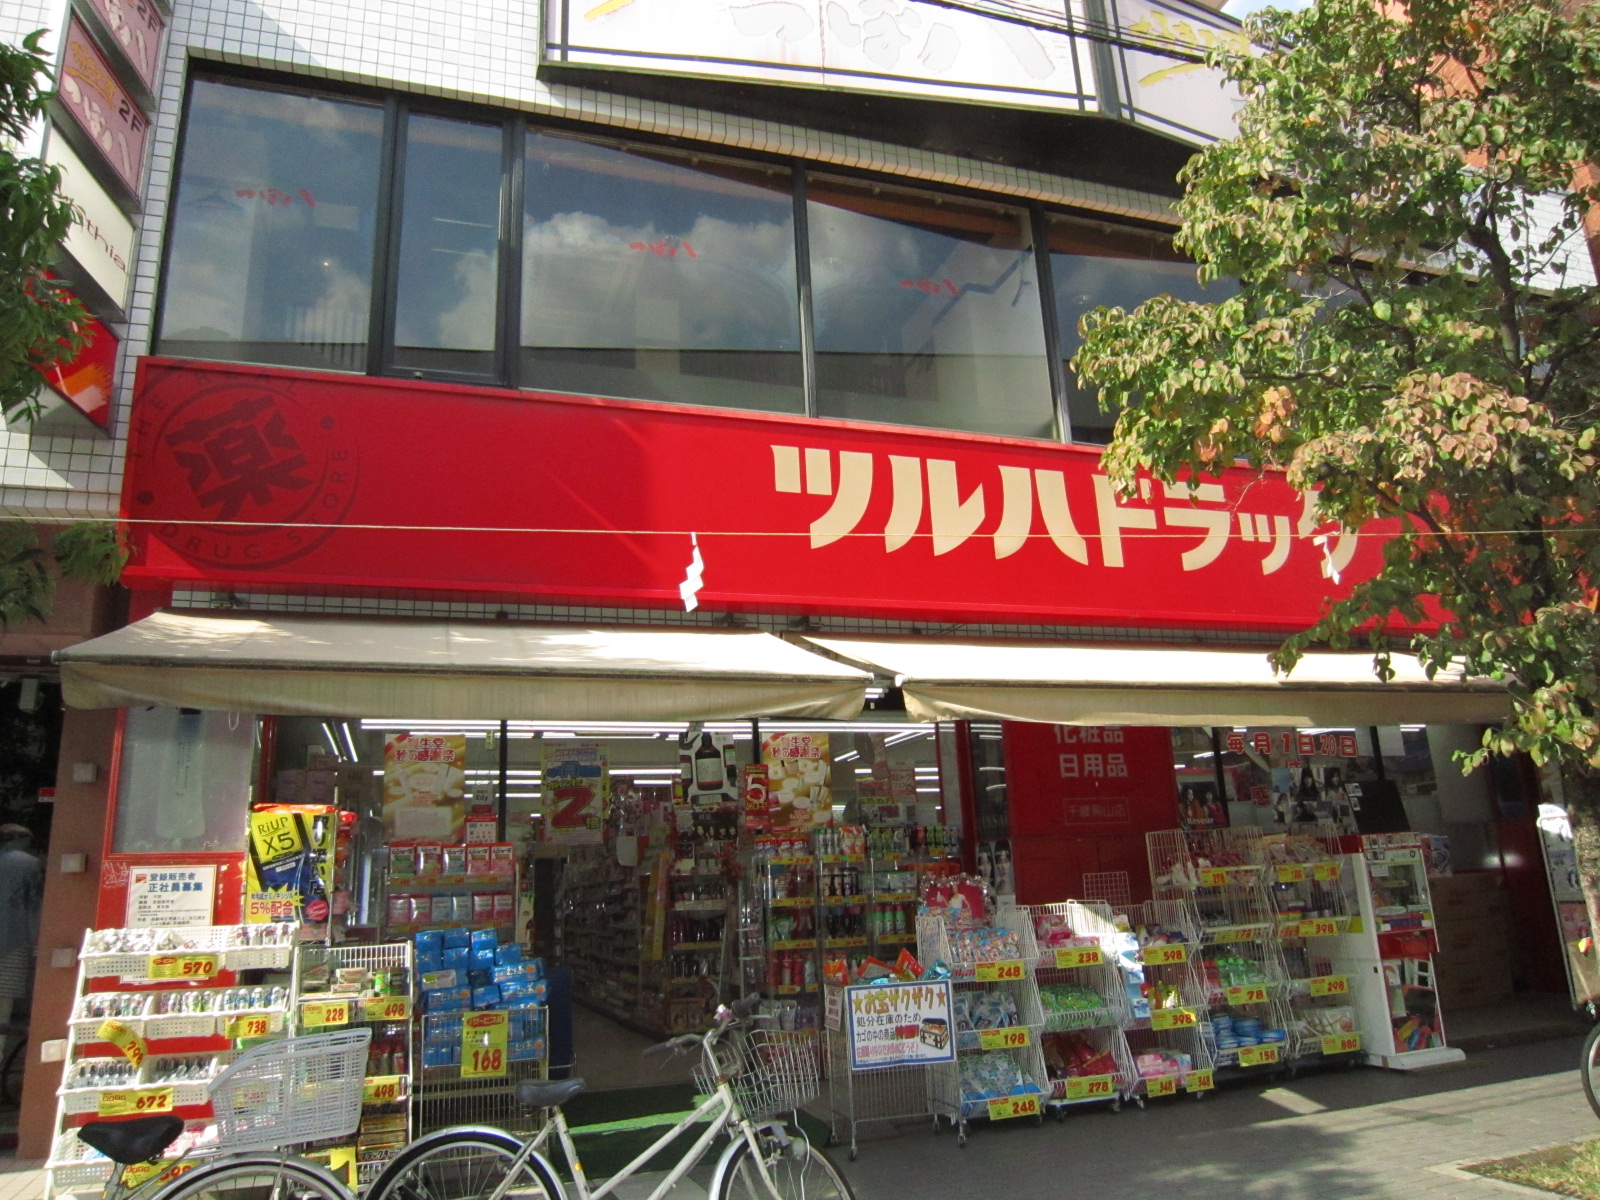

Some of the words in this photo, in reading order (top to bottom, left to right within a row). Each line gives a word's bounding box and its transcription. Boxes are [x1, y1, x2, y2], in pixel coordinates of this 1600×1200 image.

[119, 99, 142, 133] 2F
[1059, 753, 1128, 778] 日用品
[257, 816, 288, 835] RiUP
[262, 832, 295, 855] X5
[250, 900, 293, 916] 5%配合
[1315, 923, 1334, 934] 398
[1078, 952, 1099, 964] 238
[1163, 950, 1183, 961] 598
[183, 961, 213, 975] 570
[997, 966, 1021, 978] 248
[1327, 981, 1345, 992] 298
[1247, 989, 1264, 1000] 78
[325, 1007, 344, 1022] 228
[384, 1002, 405, 1017] 498
[856, 1011, 921, 1028] 処分在庫のため
[1172, 1013, 1192, 1024] 398
[247, 1020, 267, 1034] 738
[1003, 1033, 1026, 1045] 198
[473, 1048, 502, 1071] 168
[1259, 1050, 1276, 1061] 158
[373, 1084, 395, 1099] 498
[1088, 1081, 1109, 1093] 278
[136, 1094, 168, 1109] 672
[1012, 1100, 1036, 1113] 248
